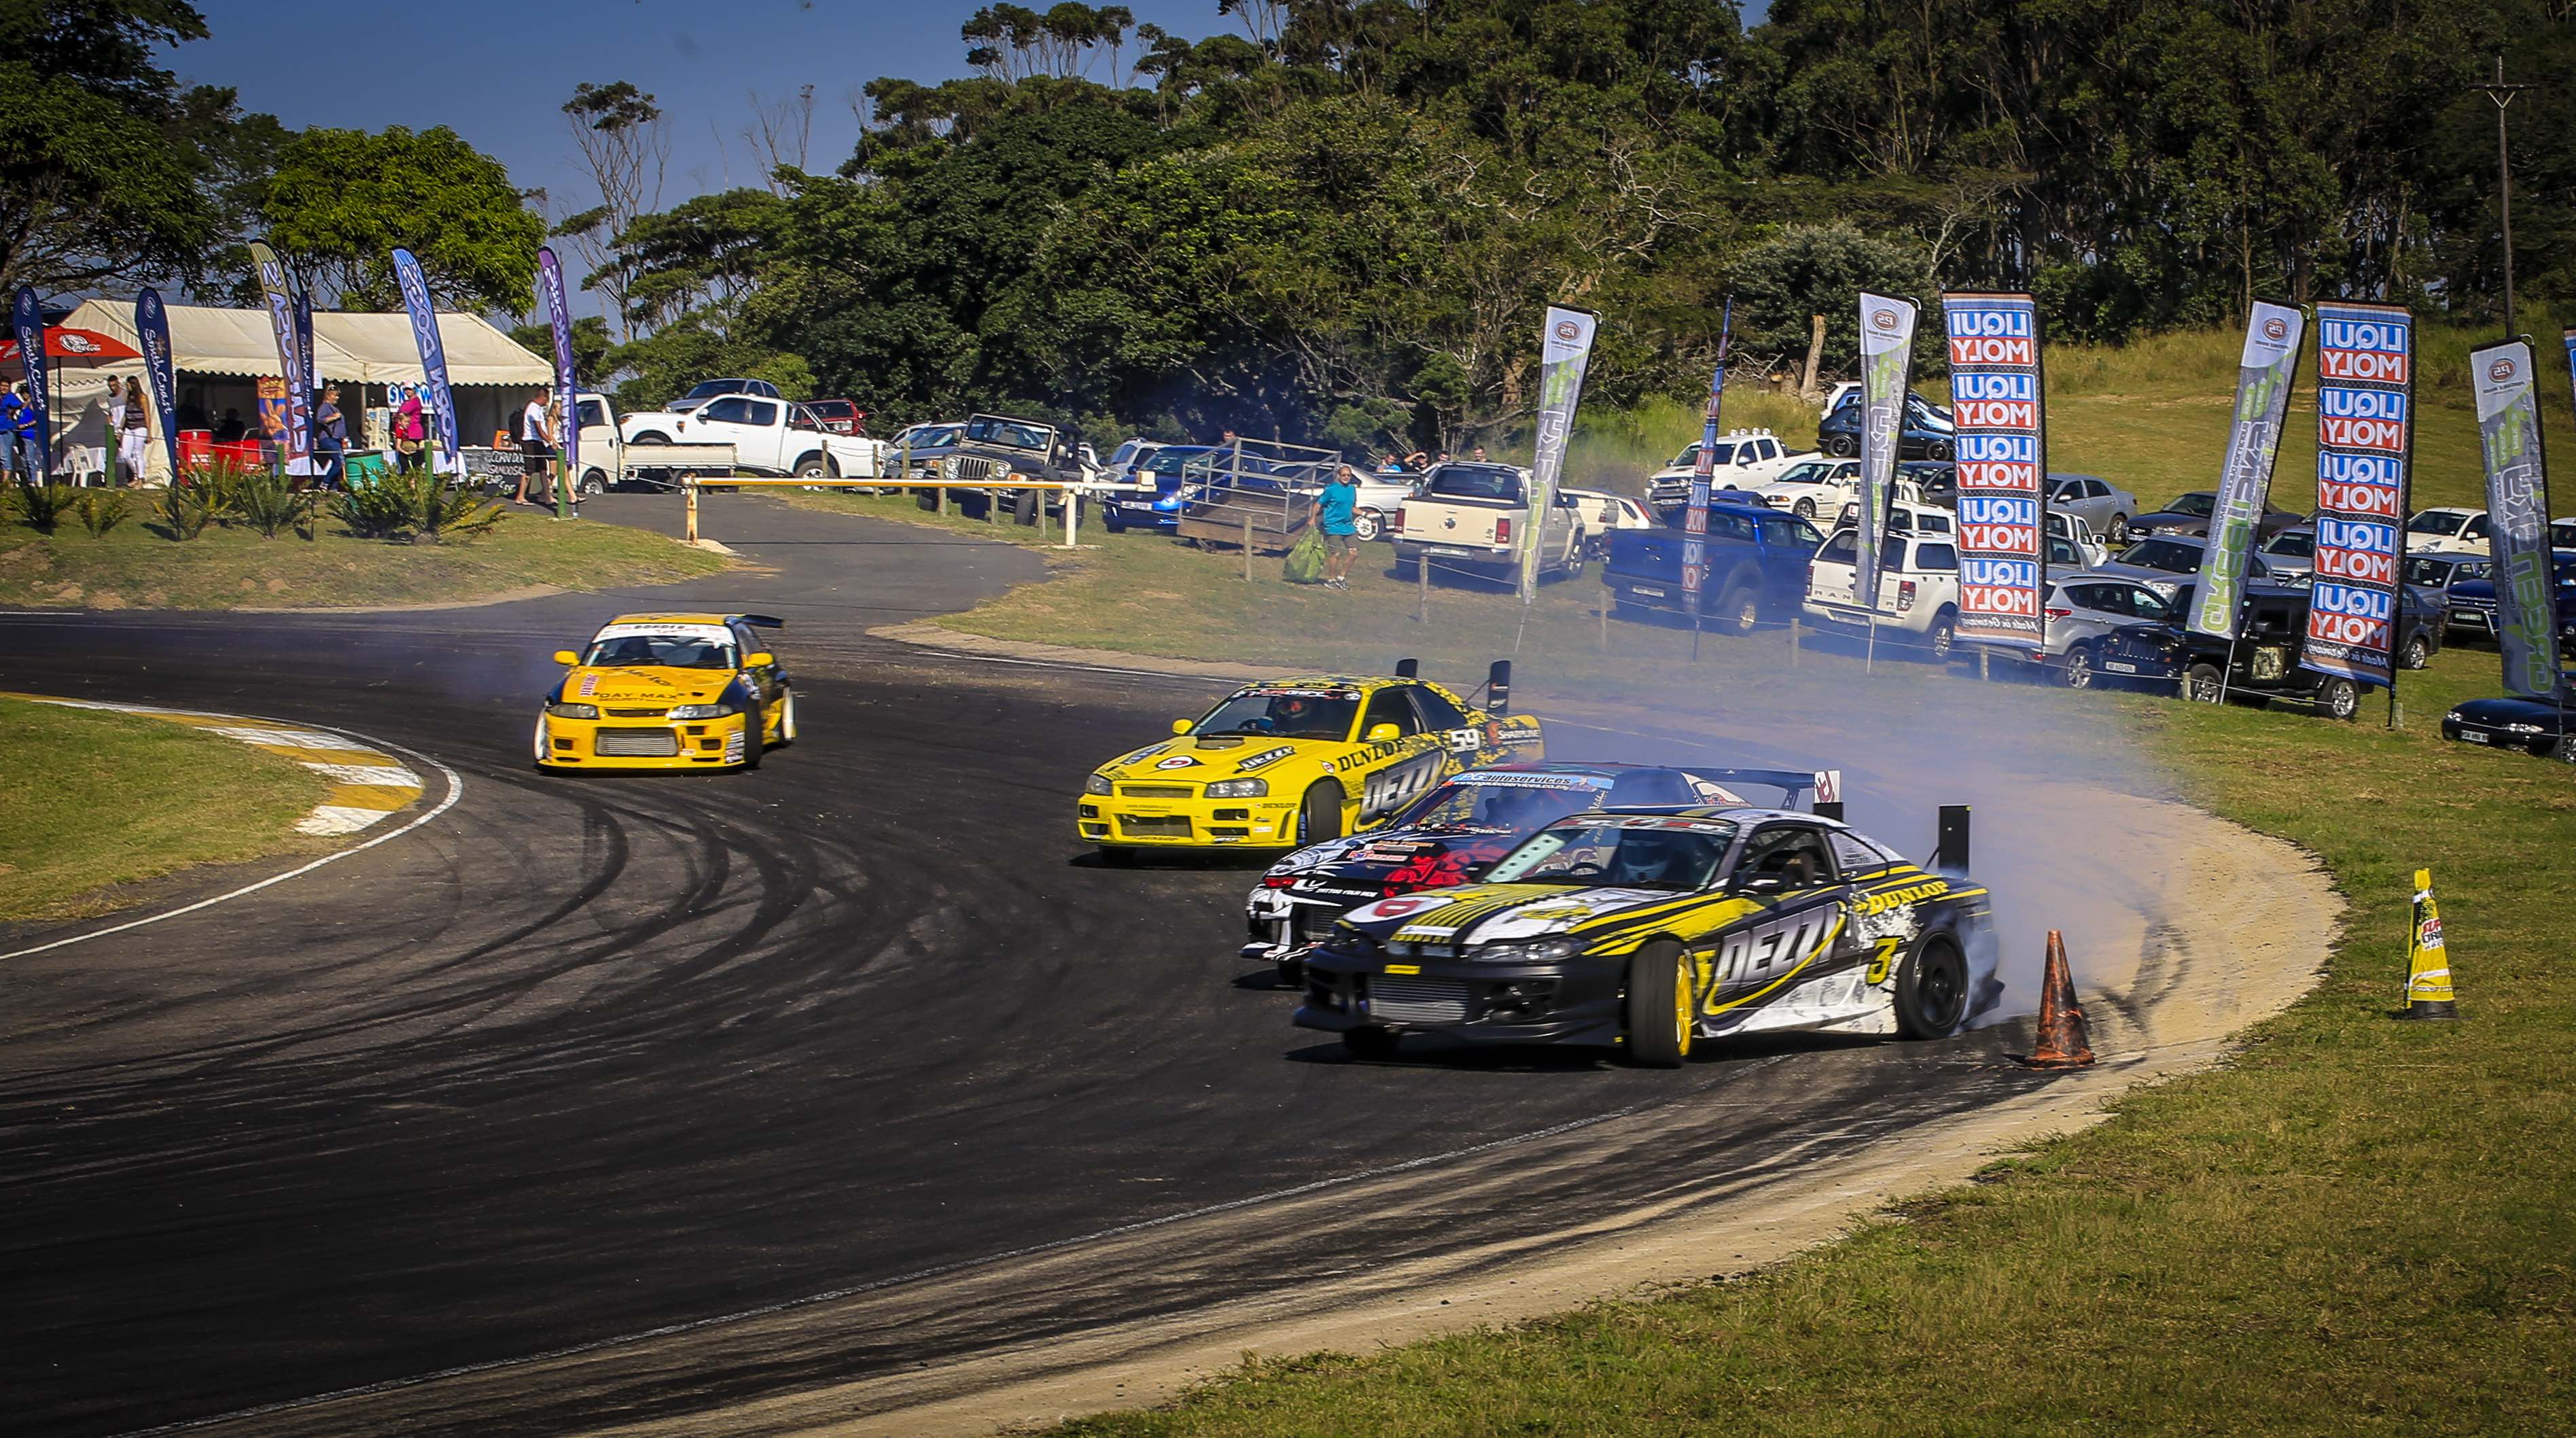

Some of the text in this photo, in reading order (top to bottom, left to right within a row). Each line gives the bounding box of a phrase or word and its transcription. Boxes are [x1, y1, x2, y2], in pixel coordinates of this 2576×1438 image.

[1449, 728, 1481, 752] 59
[1868, 881, 1950, 915] DUNLOP
[1867, 936, 1900, 985] 3
